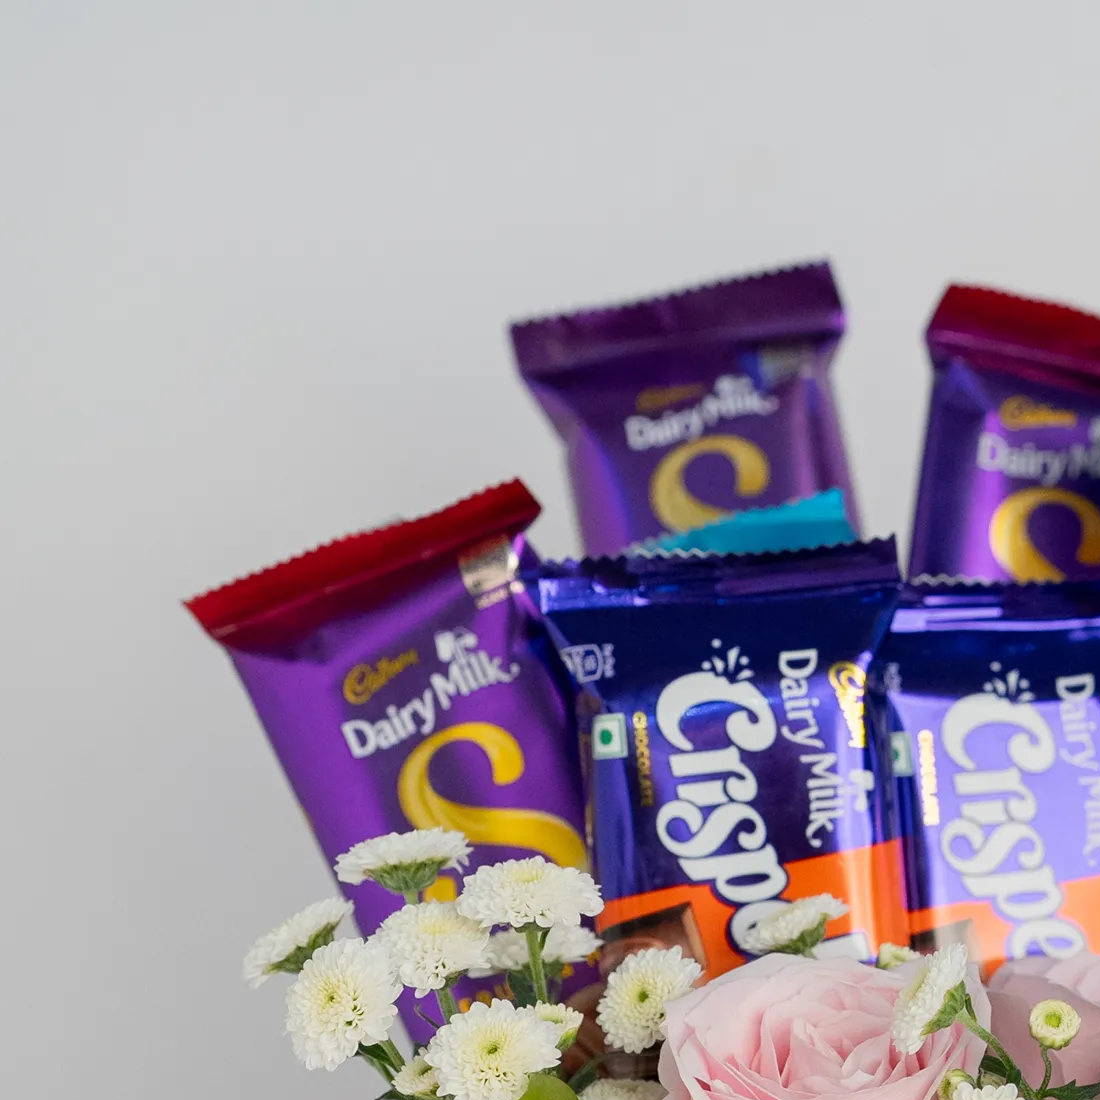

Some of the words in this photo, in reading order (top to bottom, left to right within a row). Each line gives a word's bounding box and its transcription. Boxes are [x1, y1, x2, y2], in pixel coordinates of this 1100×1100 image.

[340, 688, 435, 759] Dairy
[430, 650, 521, 711] Milk
[778, 648, 825, 749] Dairy
[1056, 673, 1100, 771] Dairy
[800, 753, 848, 848] Milk
